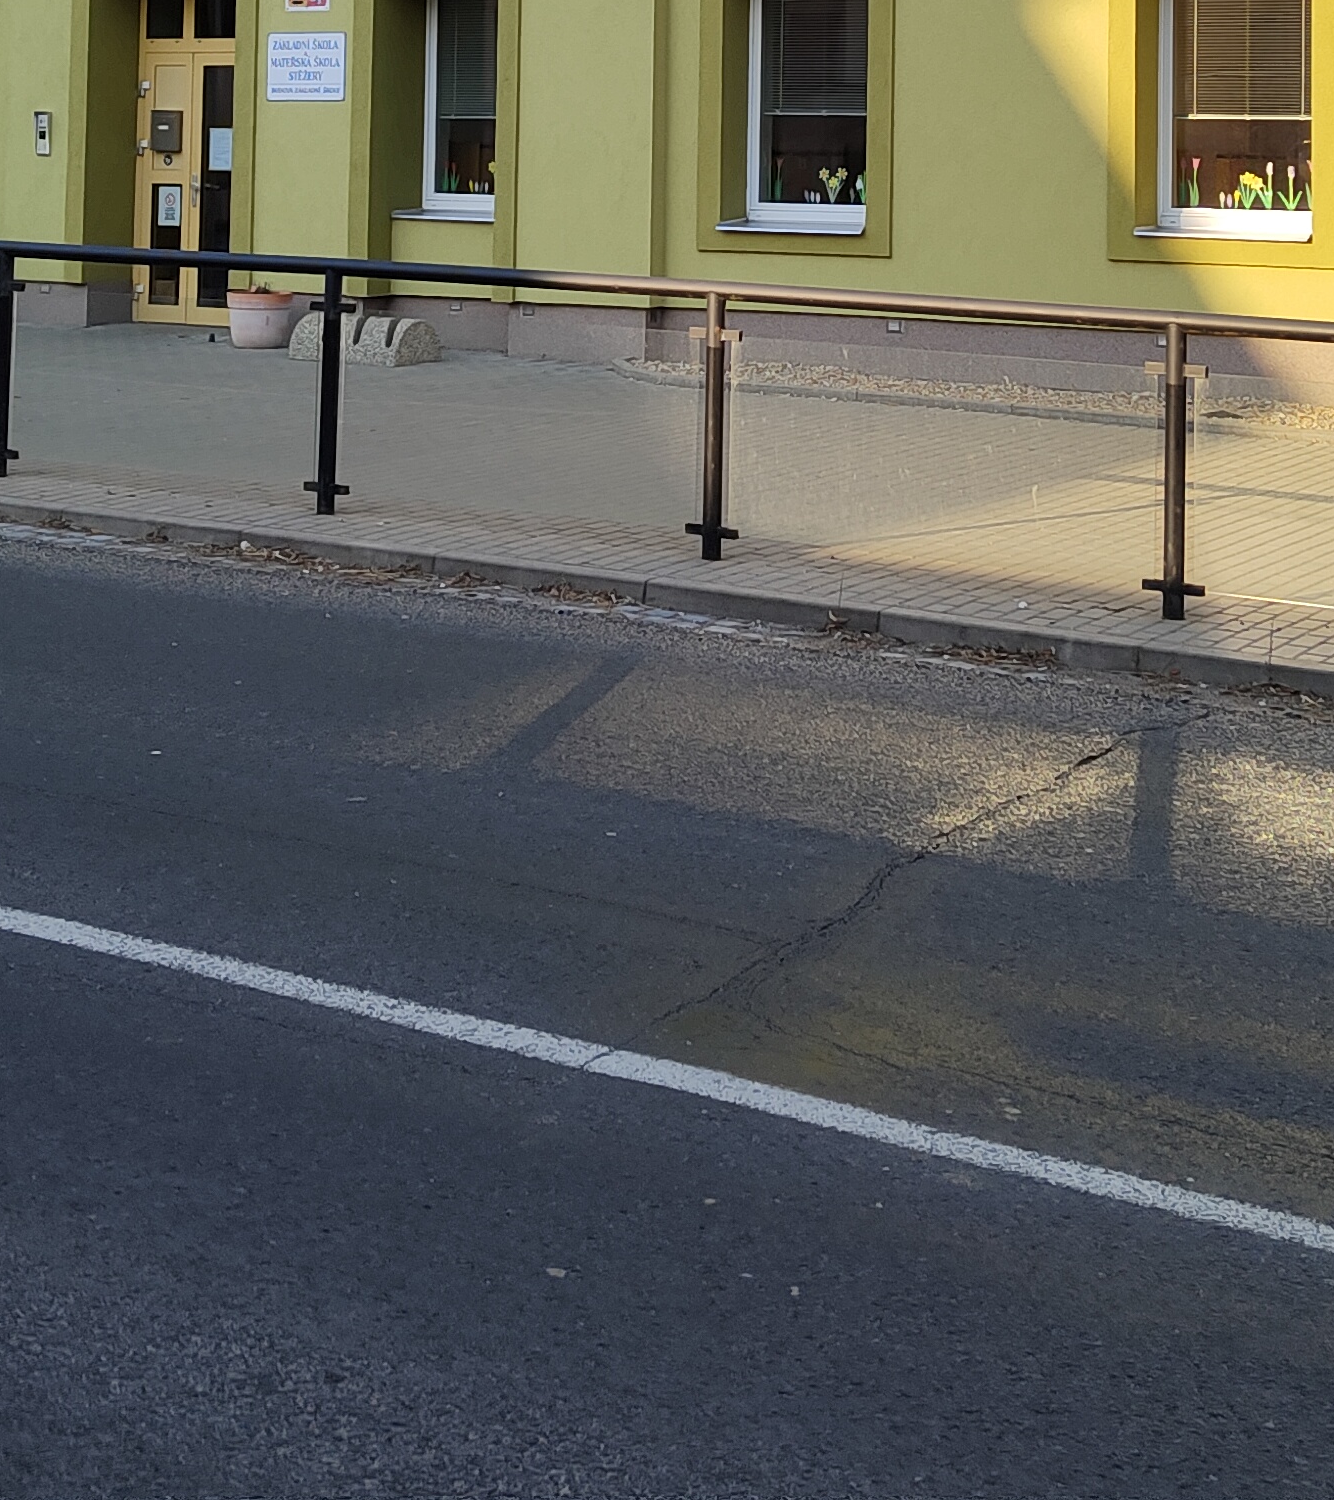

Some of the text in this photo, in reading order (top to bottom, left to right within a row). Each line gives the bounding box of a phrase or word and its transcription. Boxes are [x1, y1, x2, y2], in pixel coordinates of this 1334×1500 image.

[272, 38, 339, 50] ZÁKLADNÍ ŠKOLA
[270, 56, 340, 68] MATEŘSKÁ ŠKOLA
[288, 70, 324, 81] STĚŽERY
